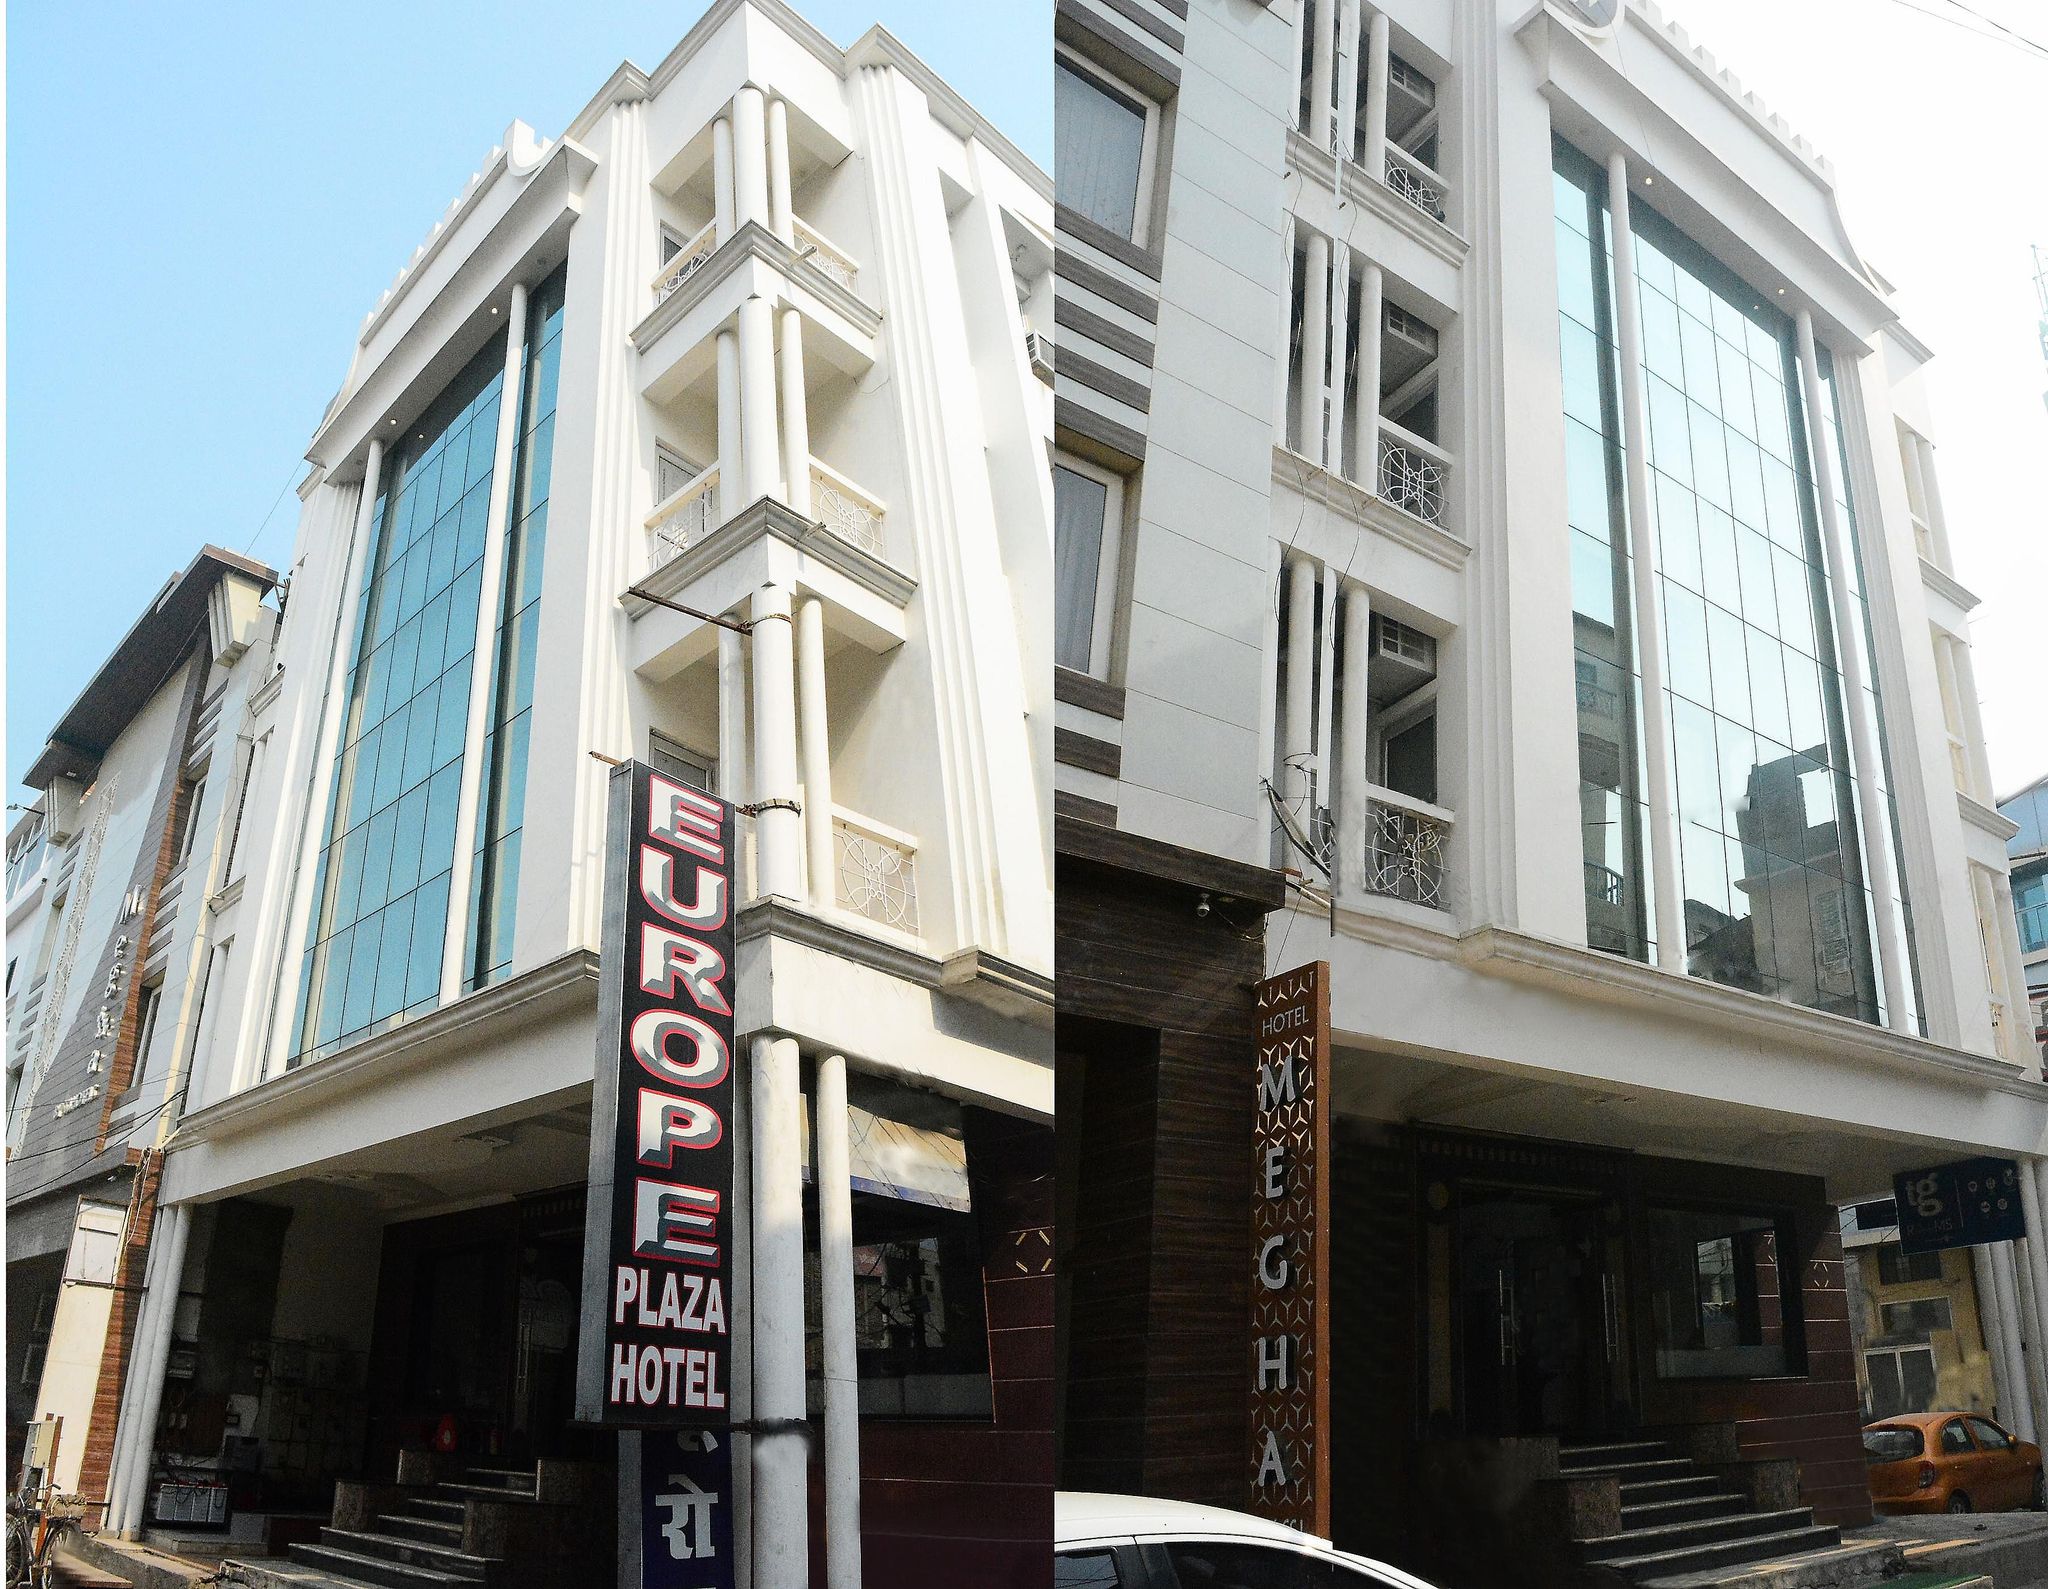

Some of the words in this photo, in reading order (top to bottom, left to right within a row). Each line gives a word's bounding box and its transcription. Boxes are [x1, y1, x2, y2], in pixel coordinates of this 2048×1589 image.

[630, 774, 733, 1267] EUROPE
[1262, 1005, 1309, 1037] HOTEL
[615, 1266, 726, 1334] PLAZA
[1258, 1055, 1296, 1487] MEGHA
[611, 1343, 725, 1408] HOTEL
